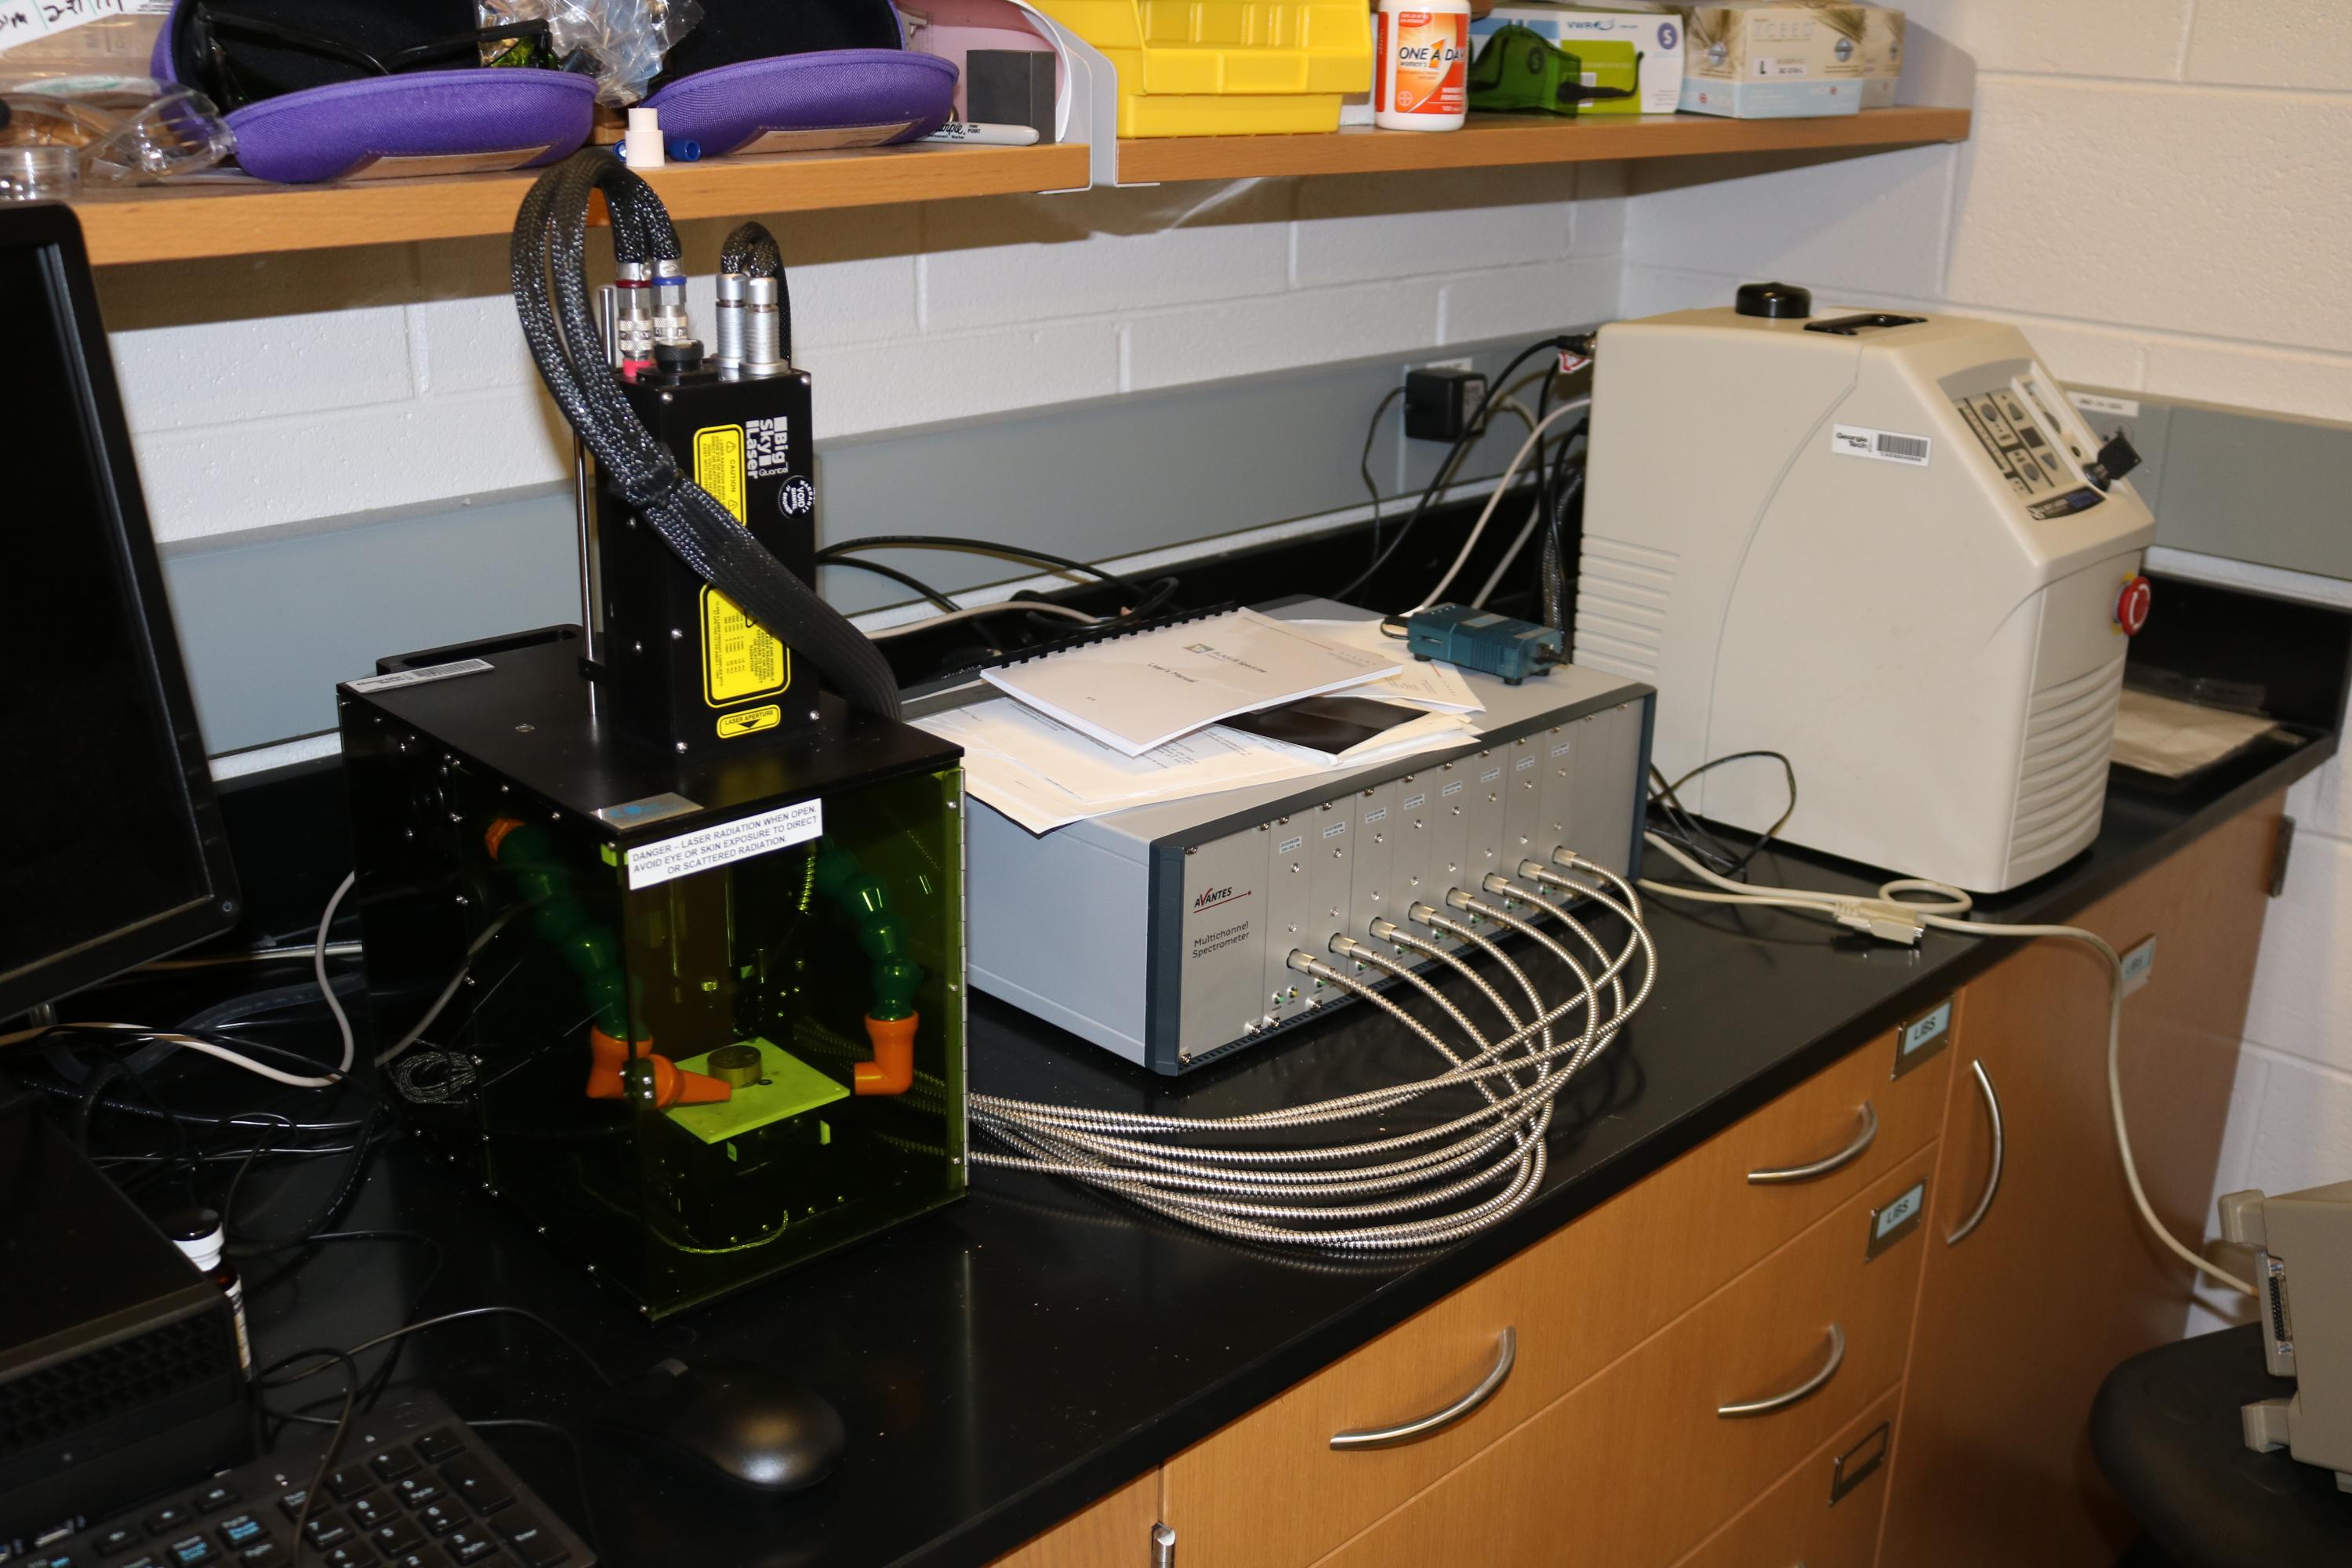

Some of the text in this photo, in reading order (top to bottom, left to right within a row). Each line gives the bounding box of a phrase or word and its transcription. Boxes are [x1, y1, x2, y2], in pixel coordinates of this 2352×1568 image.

[1662, 28, 1674, 49] S
[1399, 46, 1429, 60] ONE
[1431, 48, 1441, 60] A
[757, 419, 774, 454] Sky
[771, 432, 789, 464] Big
[746, 427, 760, 479] Laser
[797, 487, 805, 508] VOID
[800, 480, 813, 514] WARRANTY
[724, 710, 775, 725] LASER APERTURE
[633, 844, 671, 862] DANGER
[681, 833, 711, 849] LASER
[713, 819, 761, 840] RADIATION
[763, 813, 789, 826] WHEN
[791, 805, 817, 818] OPEN.
[633, 815, 818, 873] AVOID EYE OR SKIN EXPOSURE TO DIRECT
[667, 837, 787, 875] OR SCATTERED RADIATION.
[1194, 887, 1232, 908] AVANTES
[1192, 931, 1250, 959] Spectrometer
[1193, 920, 1249, 948] Multichannel
[1914, 1015, 1936, 1040] LIBS
[1886, 1199, 1909, 1224] LIBS
